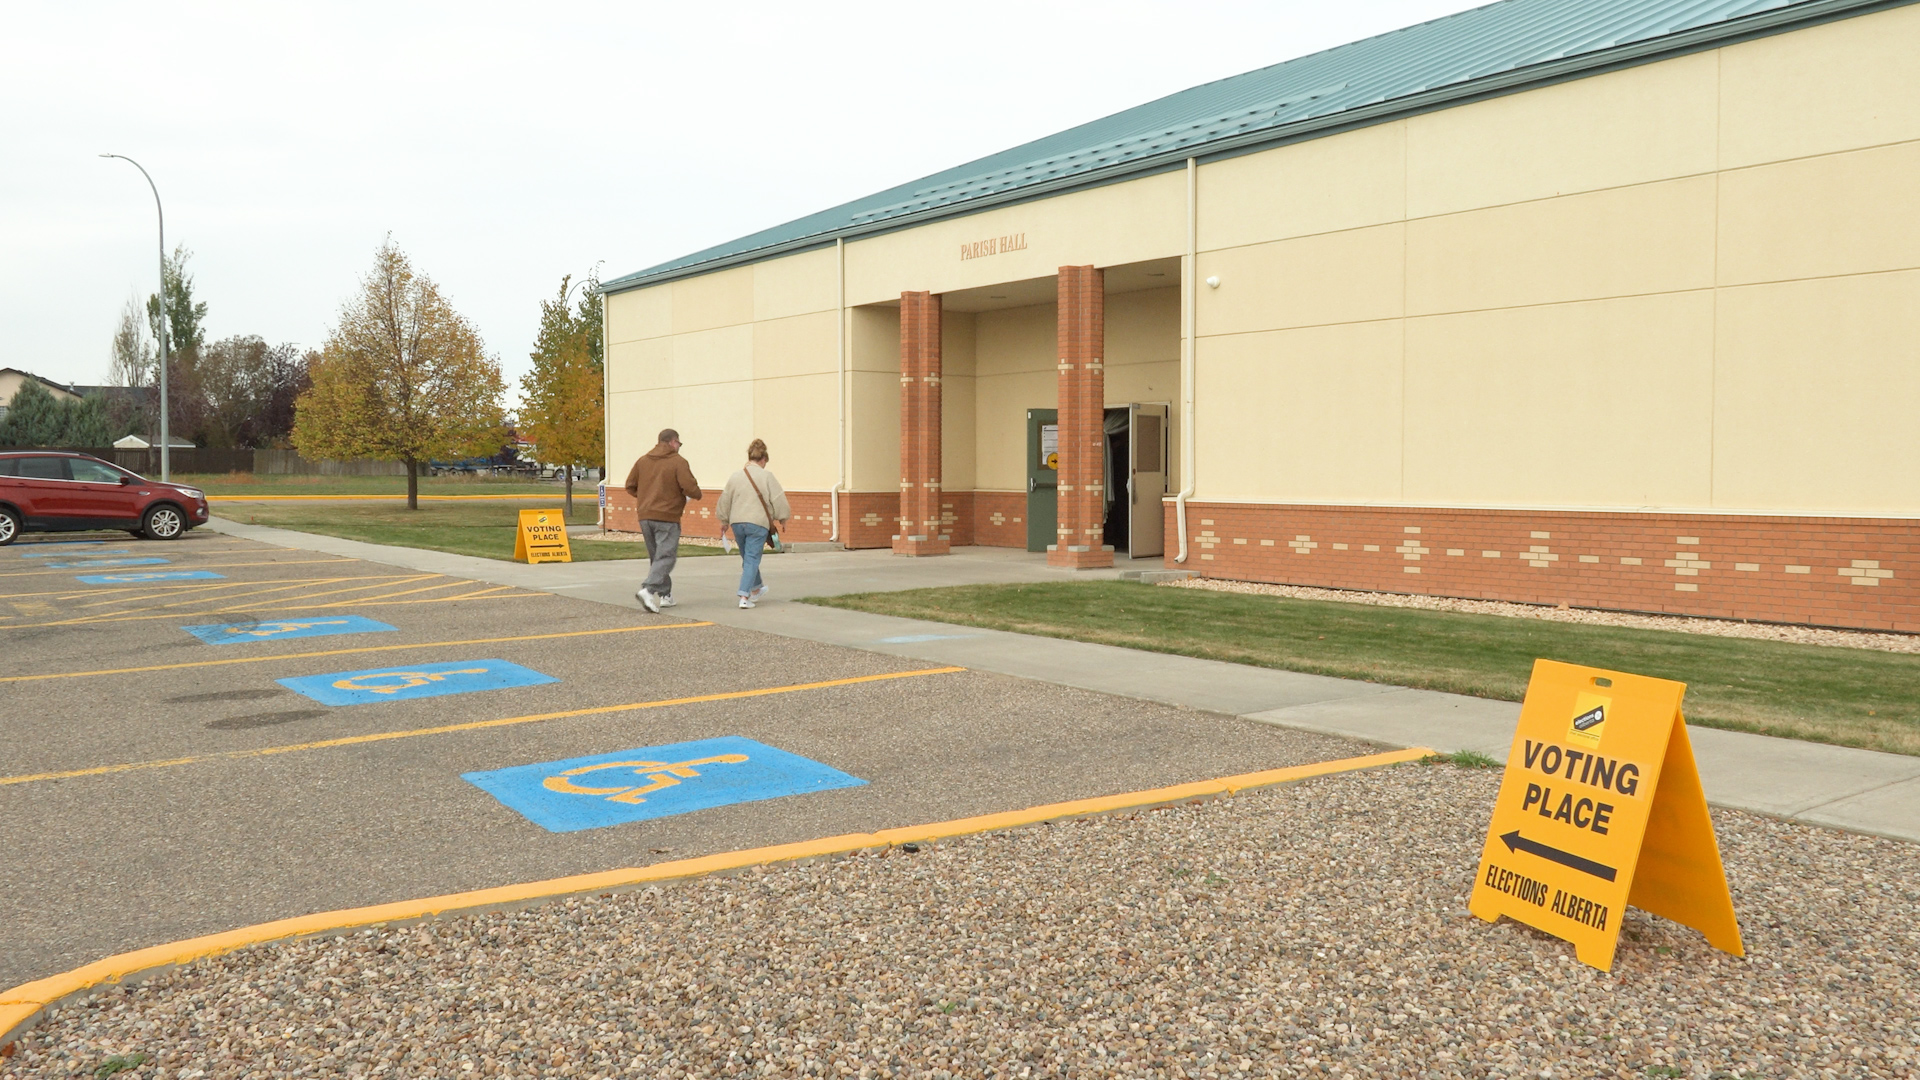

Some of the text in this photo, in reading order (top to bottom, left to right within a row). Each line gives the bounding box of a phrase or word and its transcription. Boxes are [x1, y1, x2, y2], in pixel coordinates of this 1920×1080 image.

[961, 232, 1027, 261] PARISH HALL
[527, 525, 562, 533] VOTING
[1524, 740, 1639, 796] VOTING
[1522, 783, 1614, 836] PLACE
[1485, 864, 1608, 932] ELECTIONS ALBERTA
